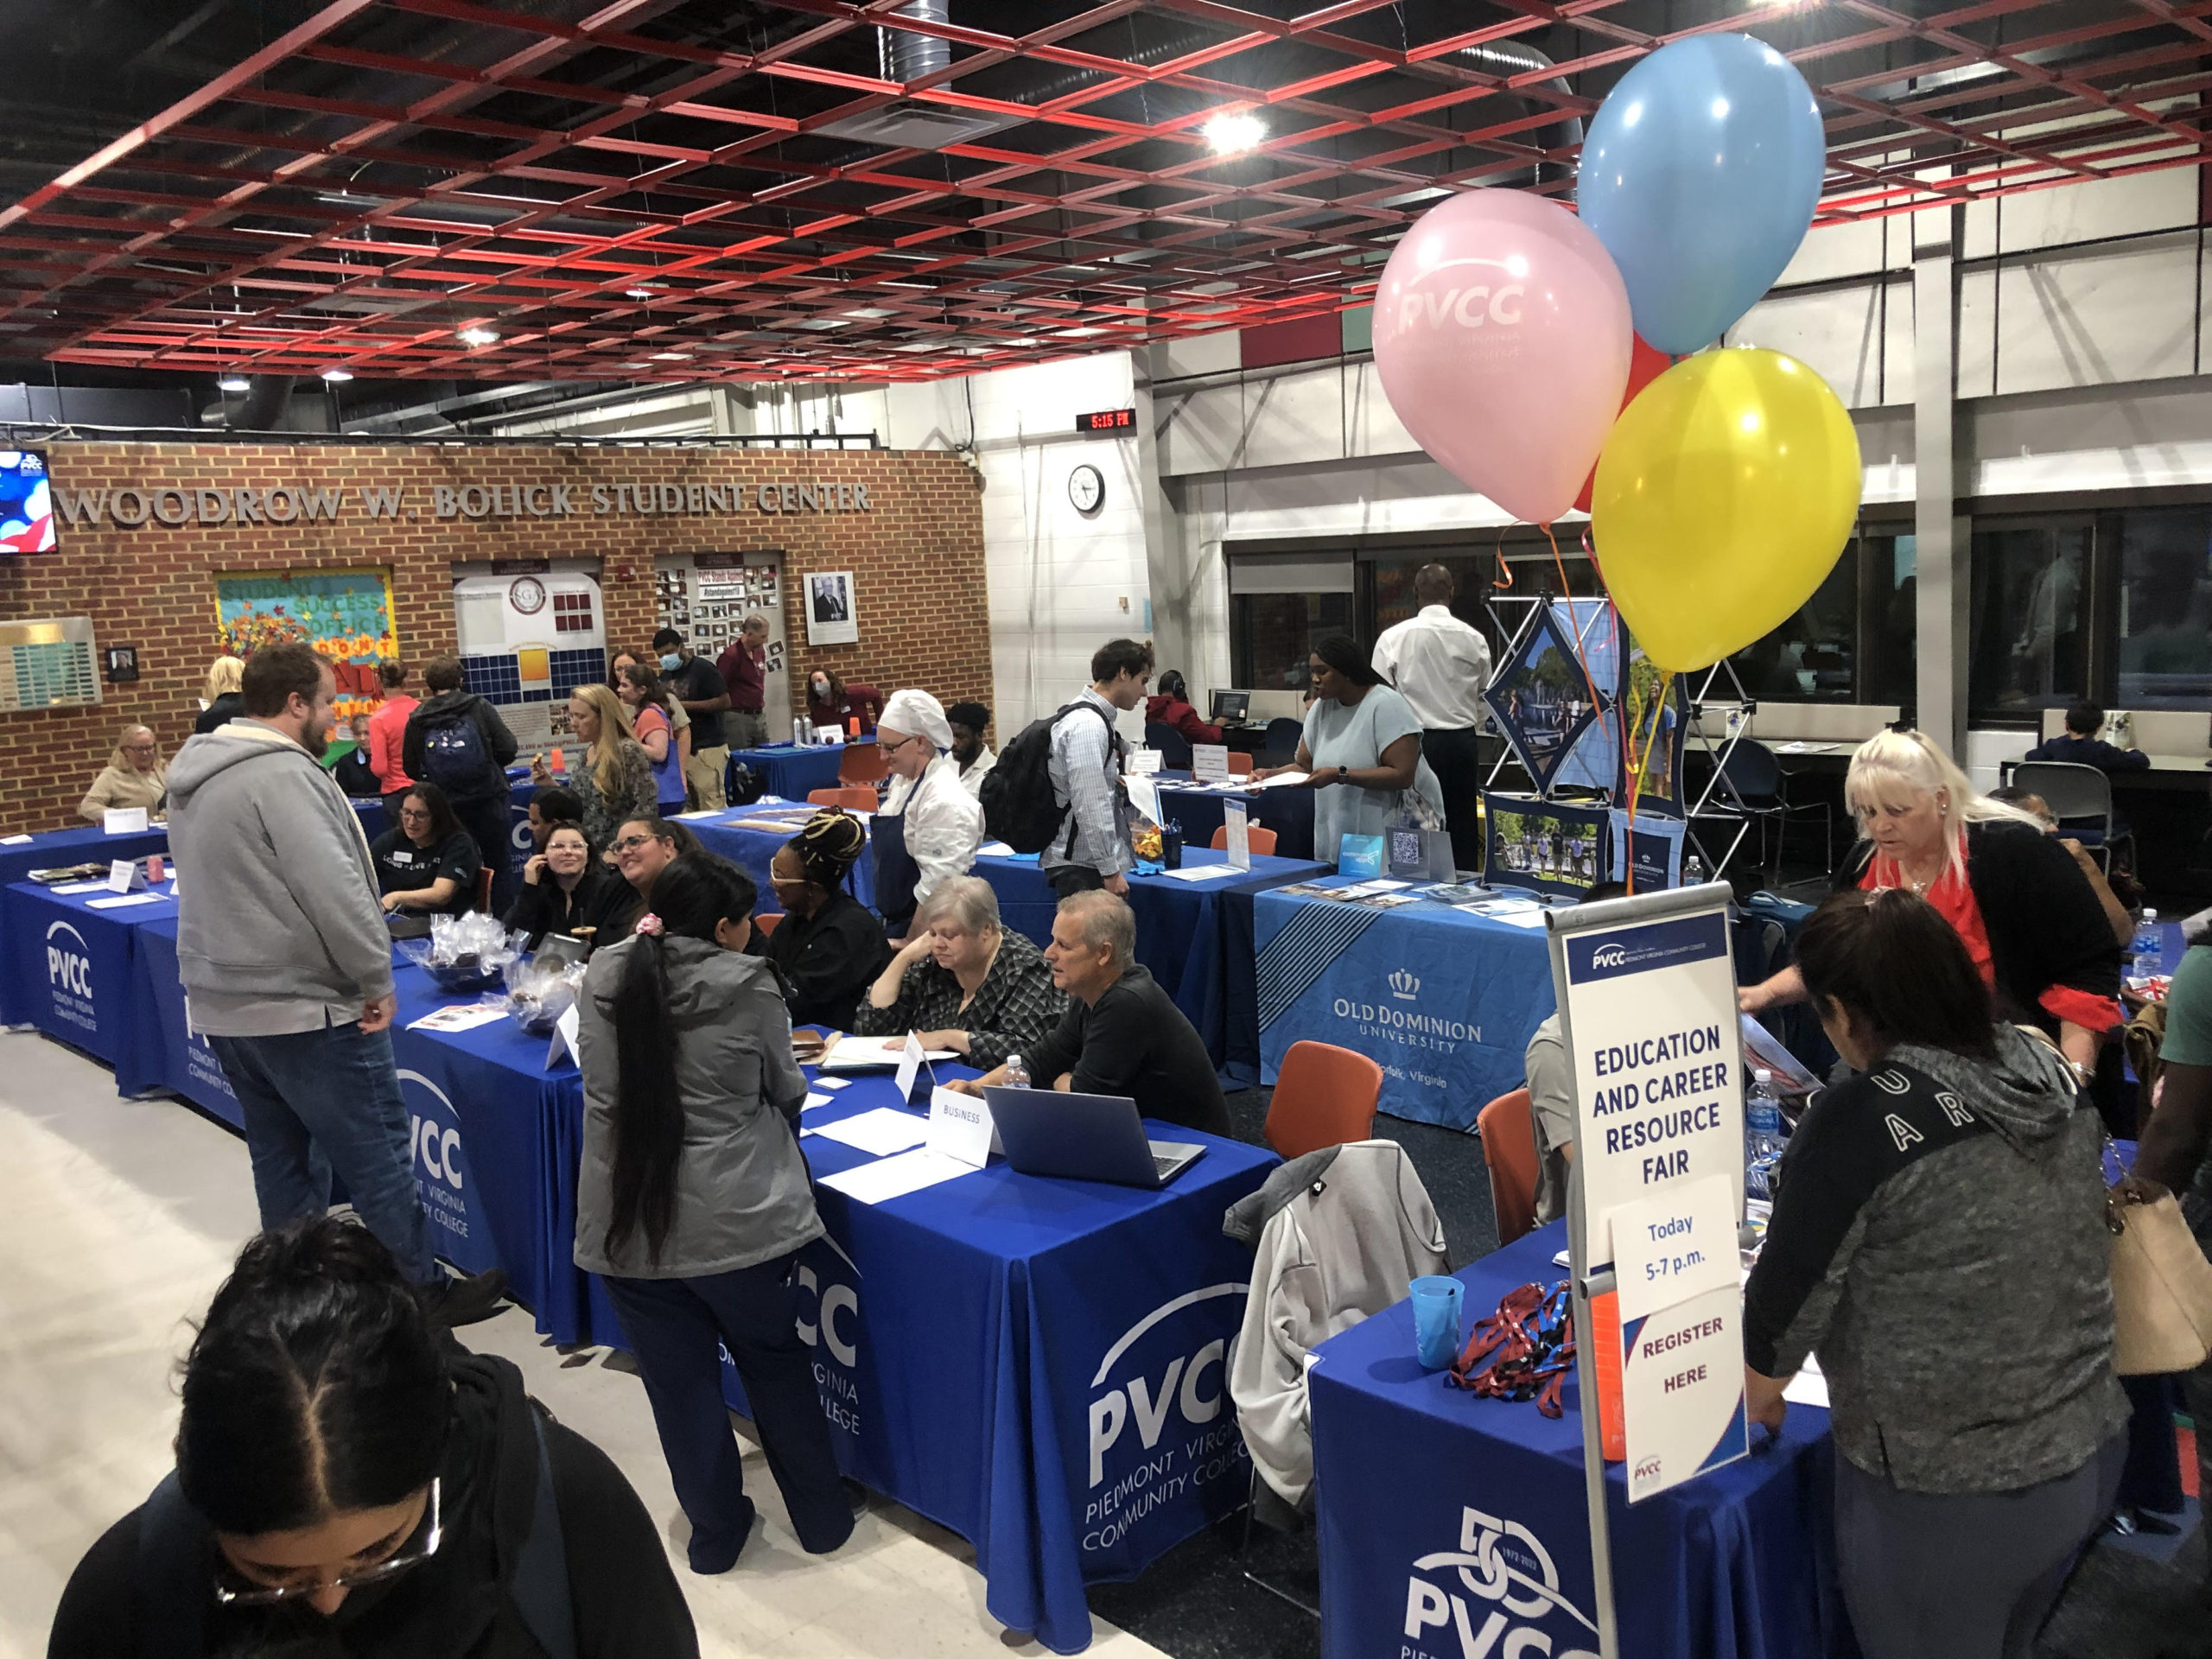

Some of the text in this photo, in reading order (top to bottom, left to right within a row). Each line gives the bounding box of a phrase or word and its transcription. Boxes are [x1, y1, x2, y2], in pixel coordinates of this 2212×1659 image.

[1398, 284, 1525, 335] PVCC
[1091, 411, 1129, 429] 5:15 PM
[50, 482, 871, 524] WOODROW W. BOLICK STUDENT CENTER
[293, 594, 380, 615] SUCCESS
[308, 616, 385, 634] OFFICE
[48, 945, 92, 999] PVCC
[1592, 951, 1625, 969] PVCC
[1333, 998, 1482, 1042] OLD DOMINION
[1359, 1024, 1456, 1054] UNIVERSITY
[1594, 1025, 1720, 1077] EDUCATION
[1379, 1064, 1447, 1089] orfolk, Virginia
[1593, 1062, 1728, 1118] AND CAREER
[1870, 1069, 1910, 1095] U
[944, 1104, 981, 1124] BUSINESS
[1606, 1102, 1720, 1154] RESOURCE
[1643, 1149, 1689, 1185] FAIR
[428, 1183, 467, 1215] VIRGINIA
[434, 1208, 468, 1237] COLLEGE
[1648, 1216, 1694, 1243] Today
[1645, 1249, 1706, 1281] 5-7 p.m.
[1643, 1316, 1723, 1358] REGISTER
[1663, 1363, 1708, 1394] HERE
[1089, 1338, 1242, 1490] PVC
[1633, 1459, 1662, 1480] PVCC
[1085, 1450, 1175, 1524] PIEDMONT
[1082, 1472, 1188, 1551] COMMUNITY
